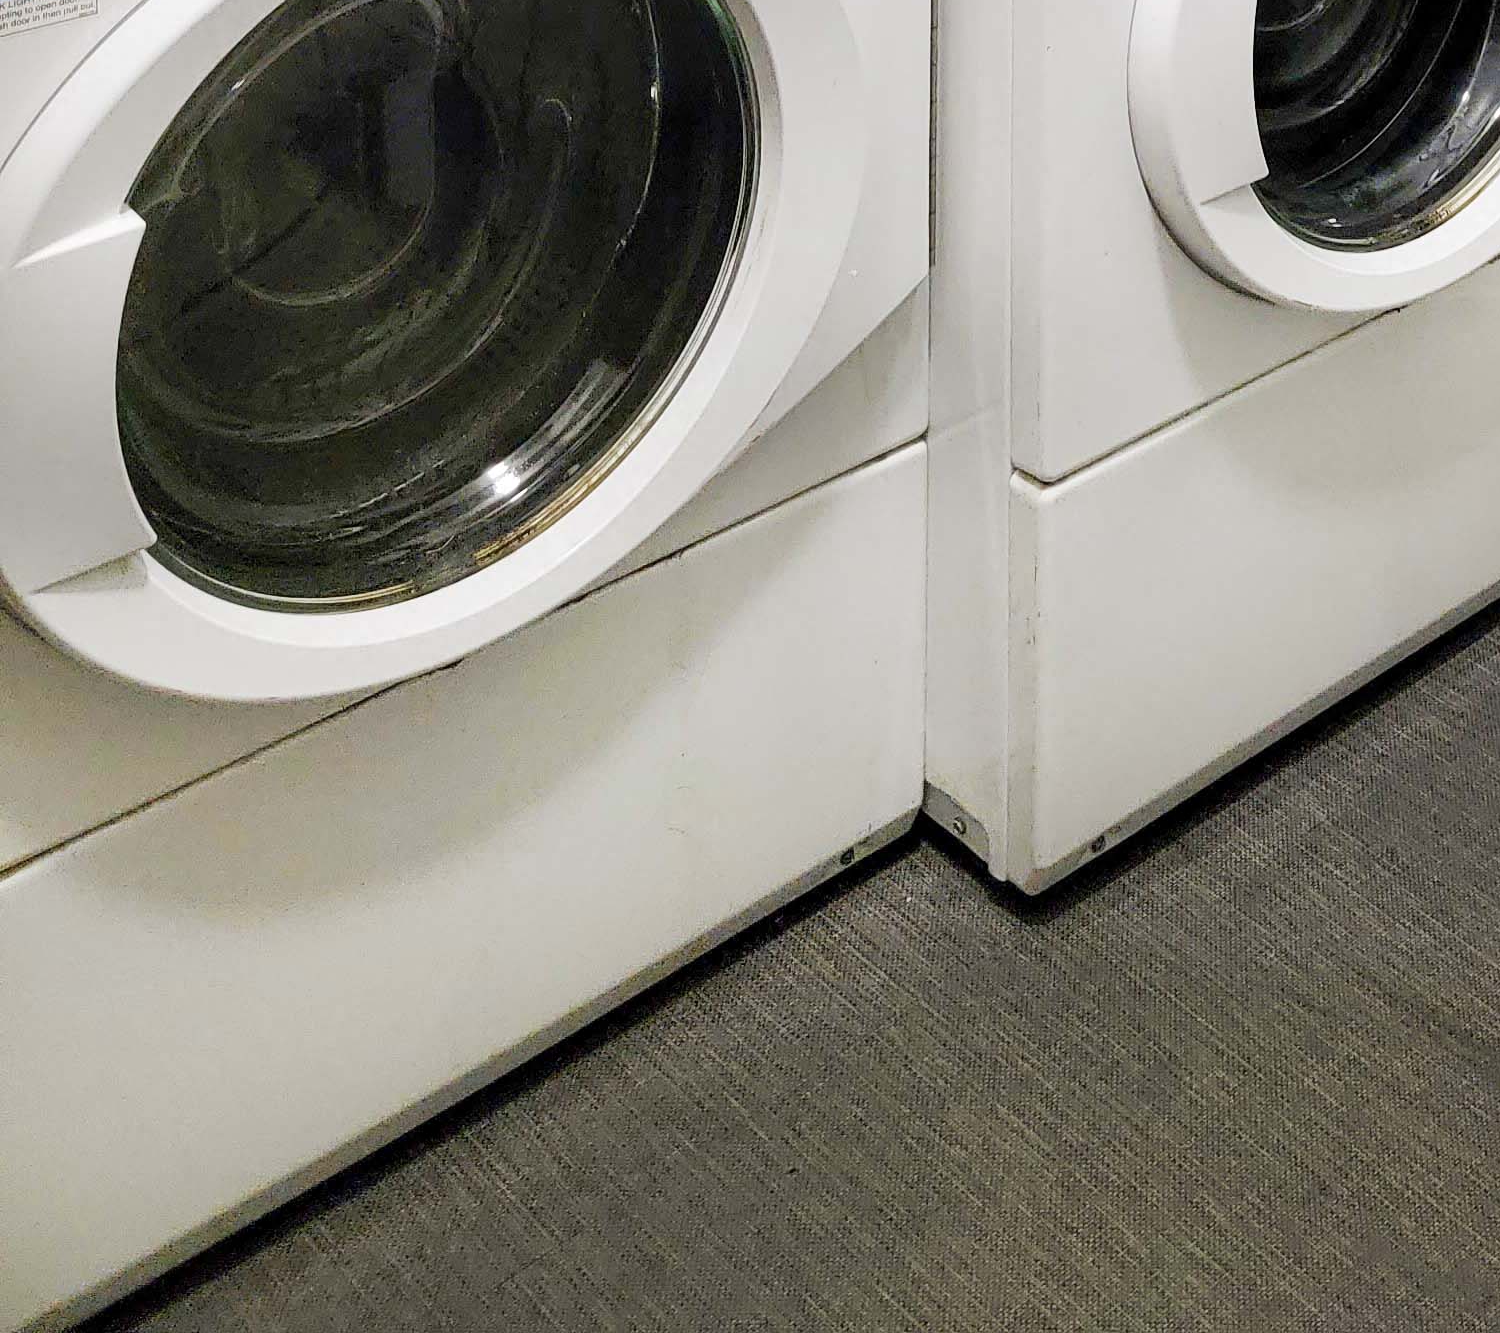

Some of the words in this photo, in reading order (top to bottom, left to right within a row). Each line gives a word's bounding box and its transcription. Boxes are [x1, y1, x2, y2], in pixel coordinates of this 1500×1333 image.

[24, 5, 33, 15] to
[35, 1, 57, 15] open
[10, 16, 30, 28] door
[32, 13, 40, 22] in
[42, 8, 61, 20] then
